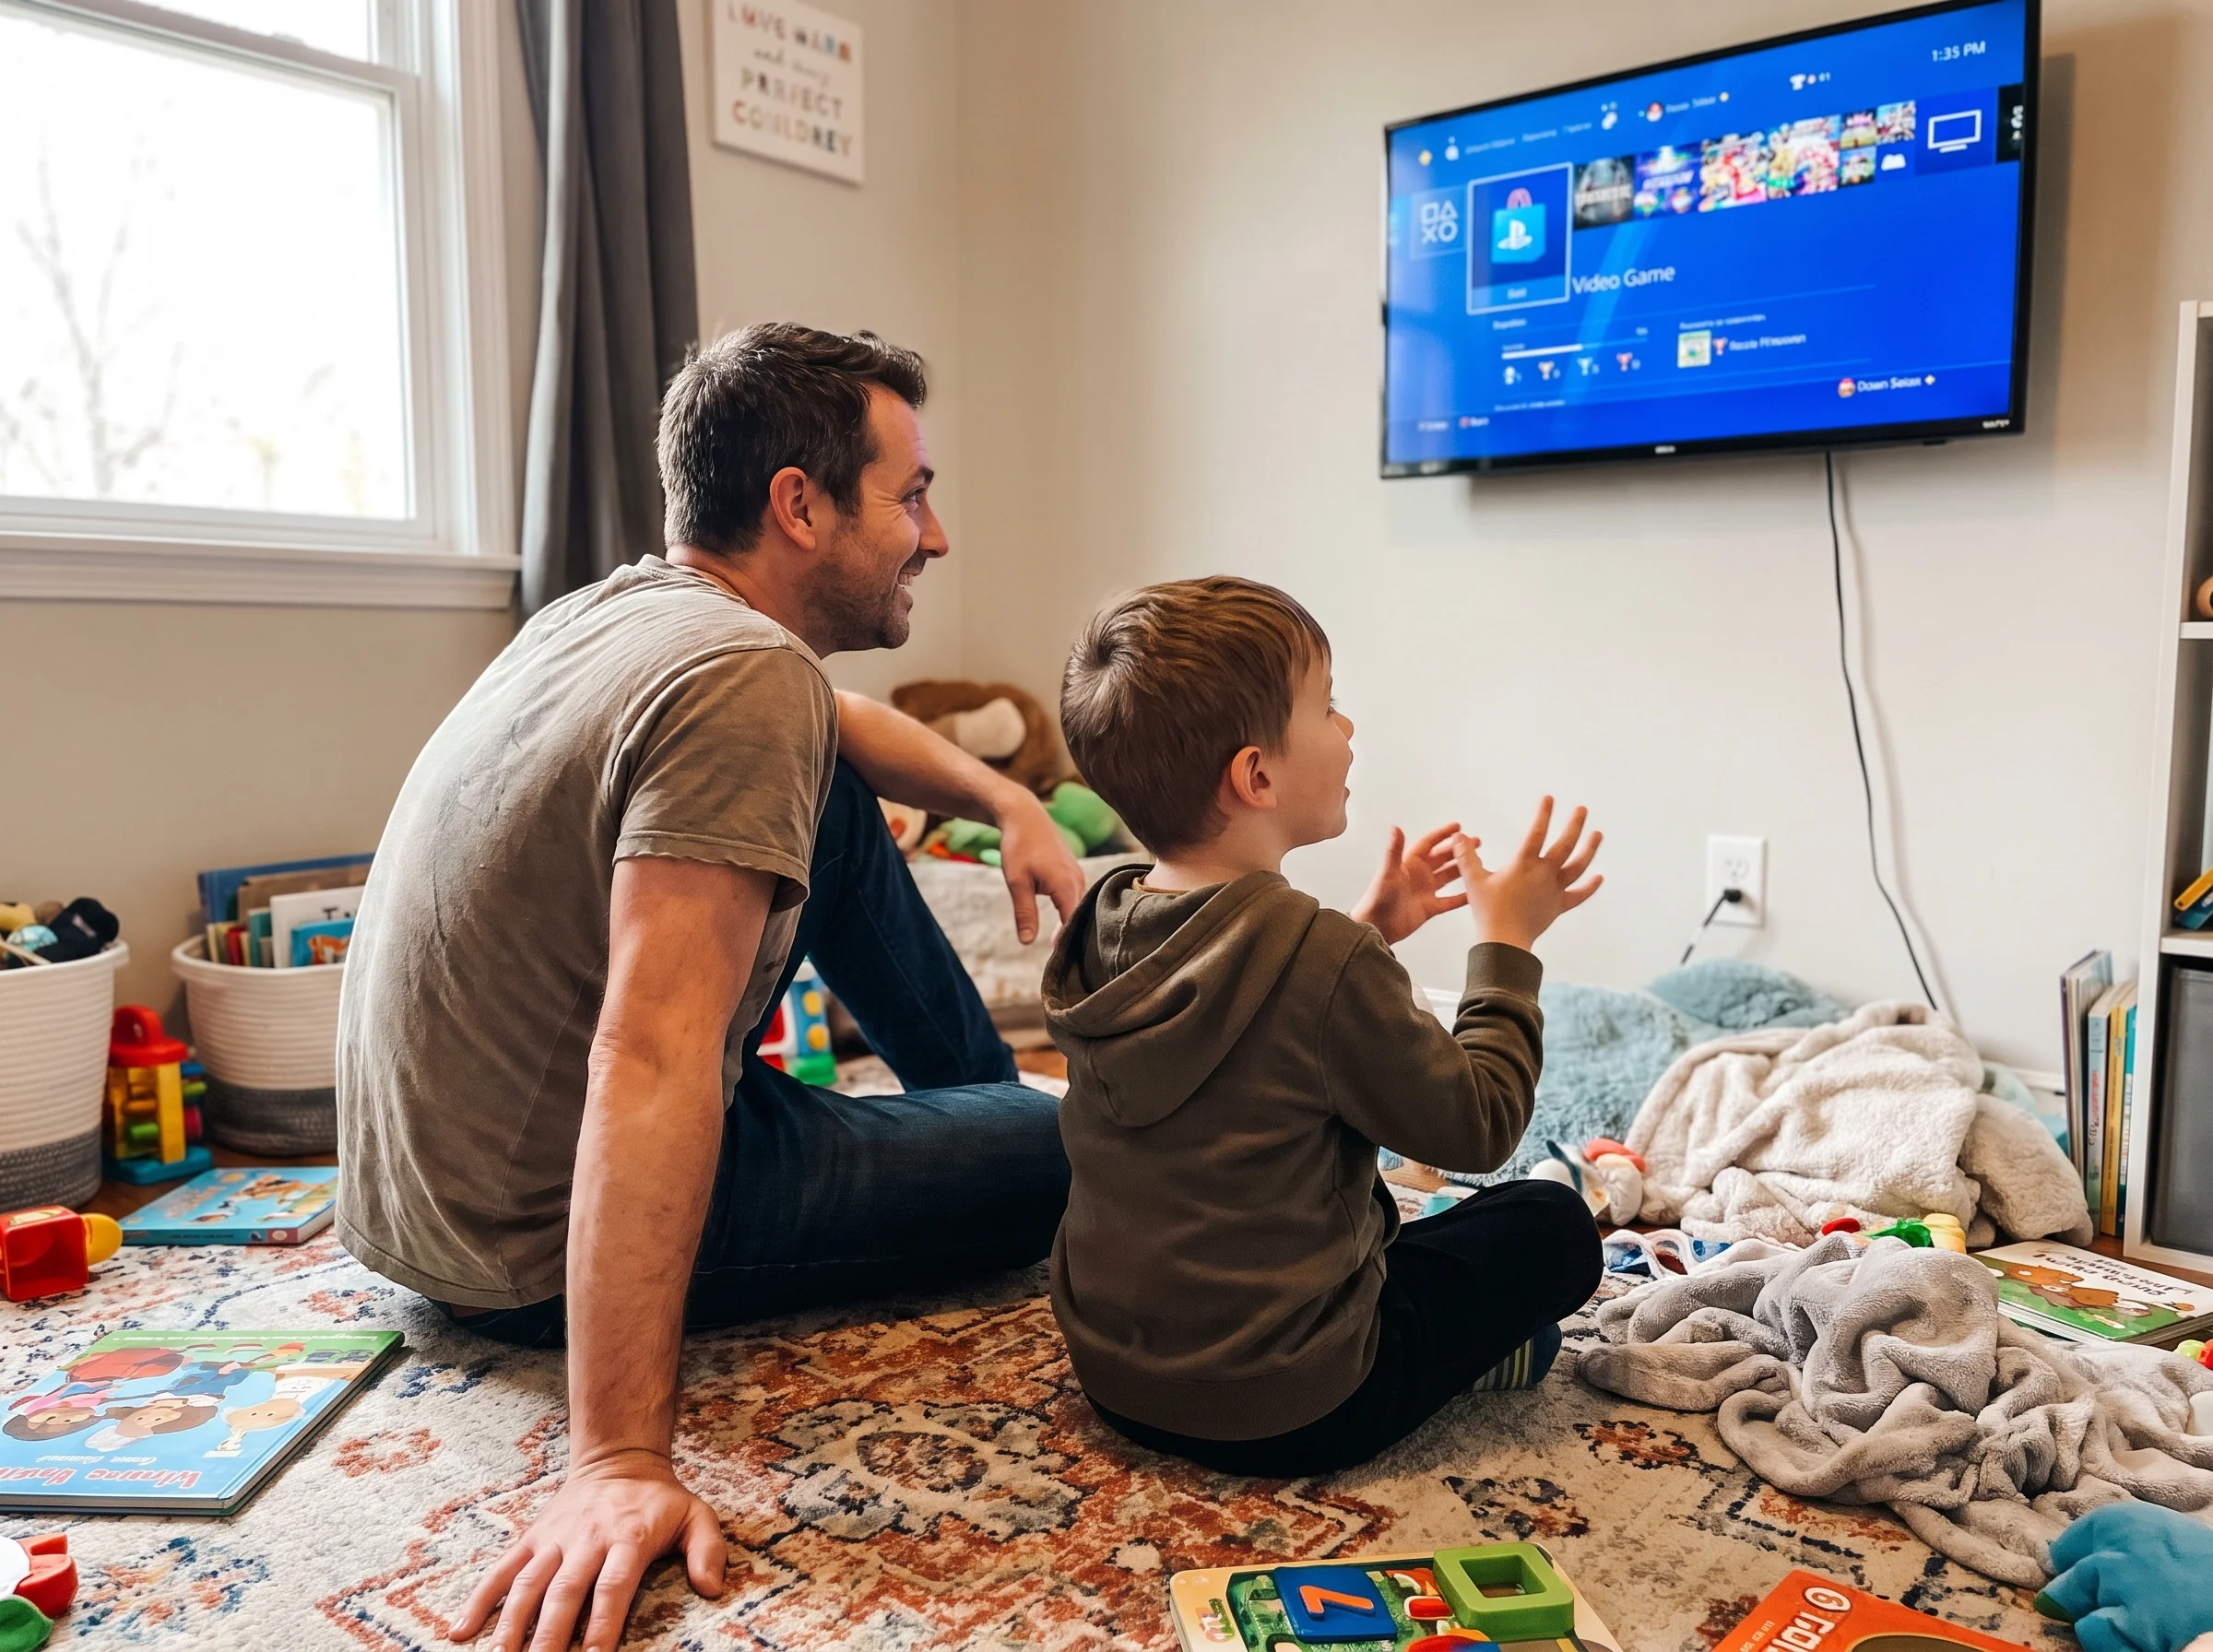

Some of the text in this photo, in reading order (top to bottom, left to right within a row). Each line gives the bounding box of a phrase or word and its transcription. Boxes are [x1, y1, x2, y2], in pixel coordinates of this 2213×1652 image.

[1932, 41, 1986, 62] 1:35 PM
[1571, 266, 1675, 295] Video Game
